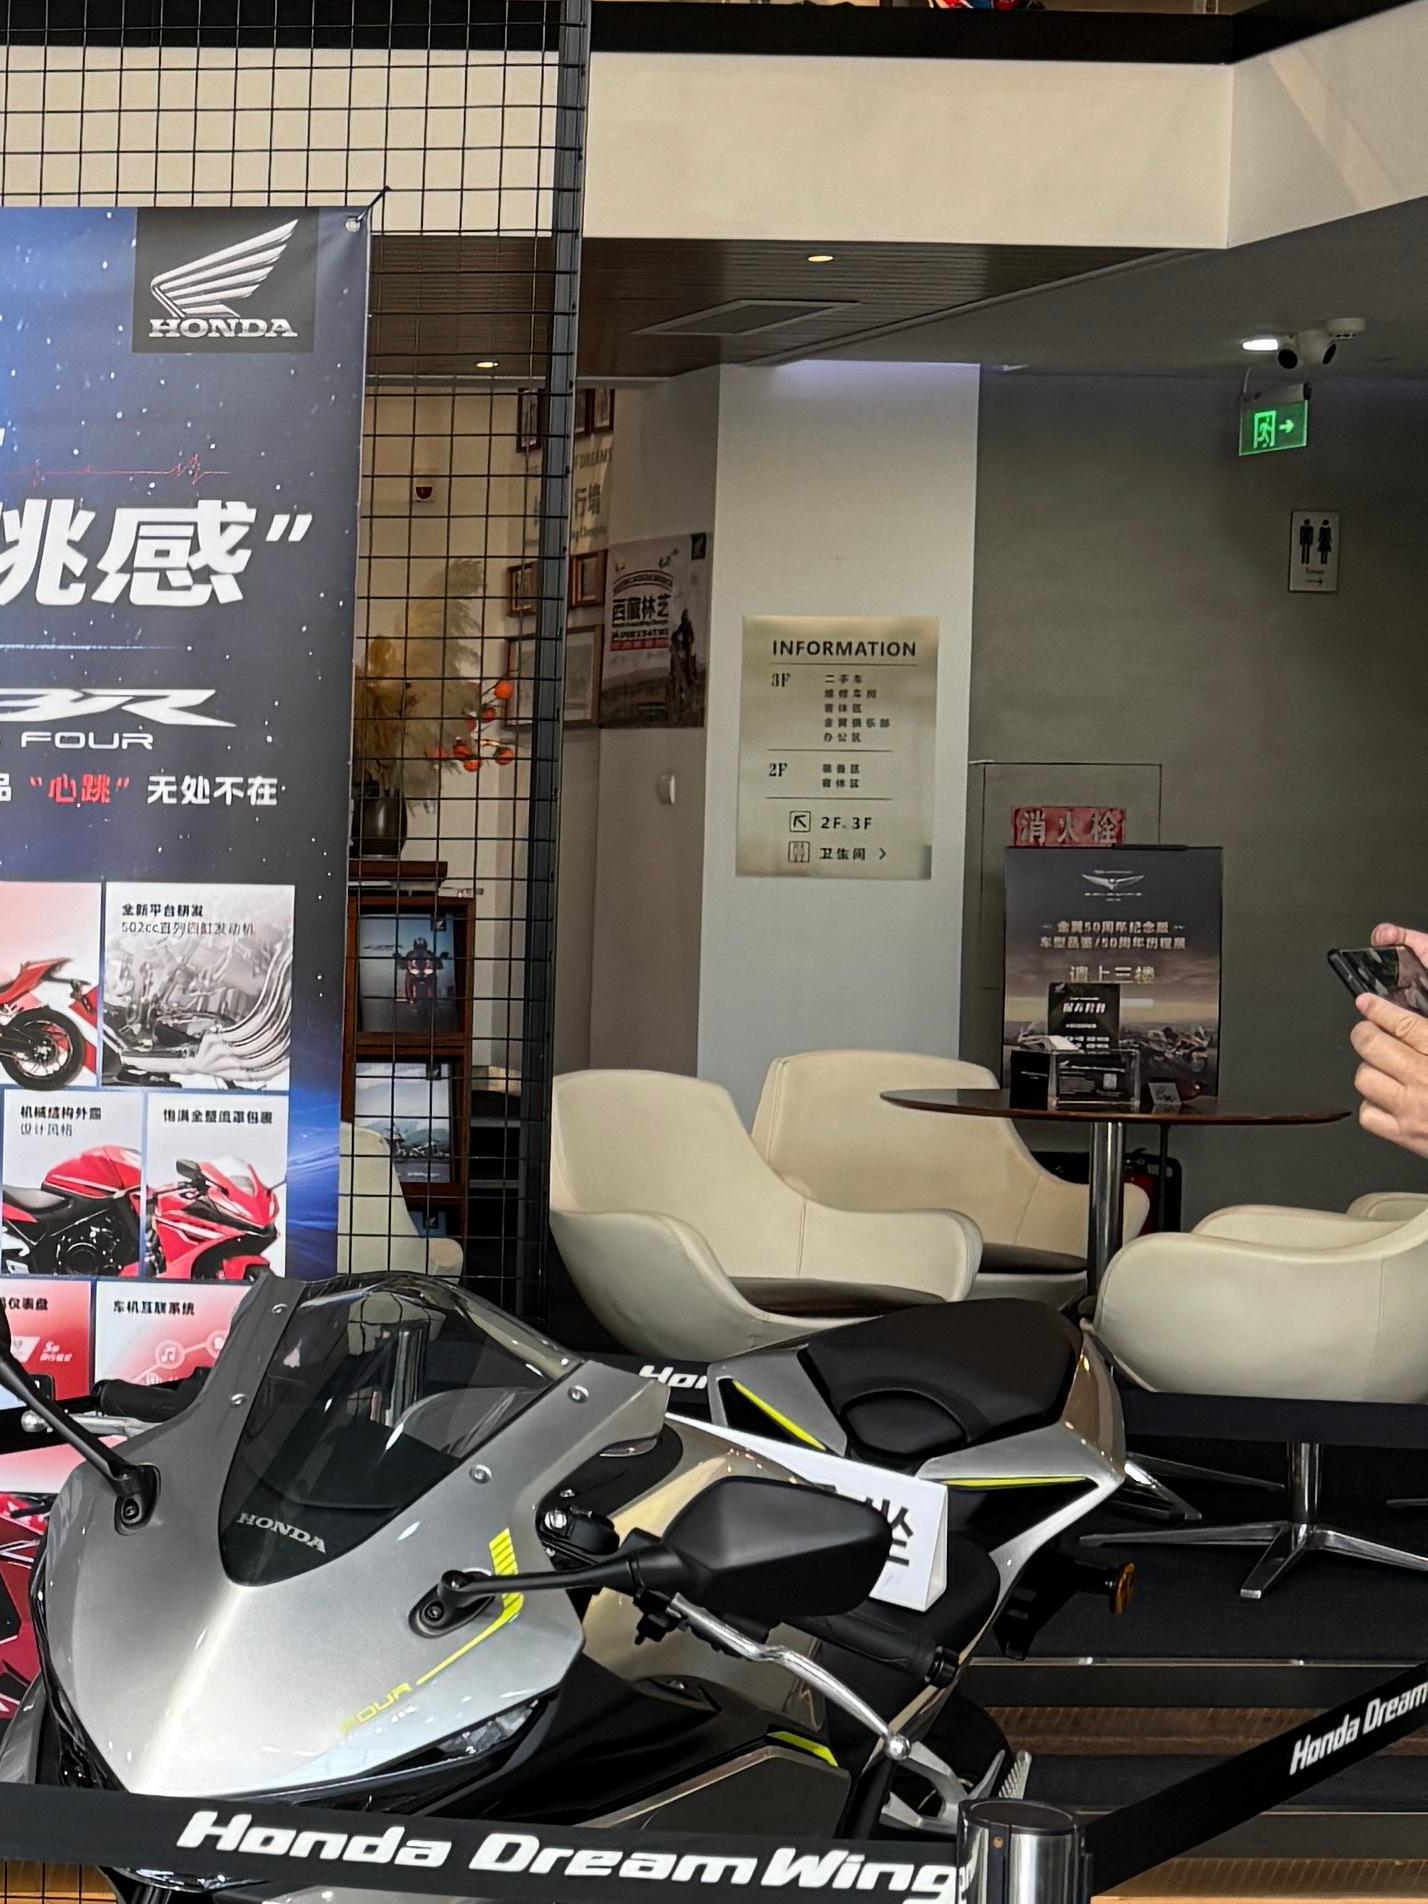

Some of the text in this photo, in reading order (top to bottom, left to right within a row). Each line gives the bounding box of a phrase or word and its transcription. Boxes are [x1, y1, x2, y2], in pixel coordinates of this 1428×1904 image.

[147, 318, 299, 339] HONDA
[772, 639, 917, 657] INFORMATION
[771, 673, 791, 688] 3F
[20, 730, 154, 751] FOUR
[768, 762, 789, 777] 2F
[1020, 809, 1119, 844] 消火栓
[819, 847, 867, 861] 卫生间
[236, 1511, 328, 1555] HONDA
[1288, 1713, 1362, 1777] Honda
[174, 1809, 451, 1870] Honda
